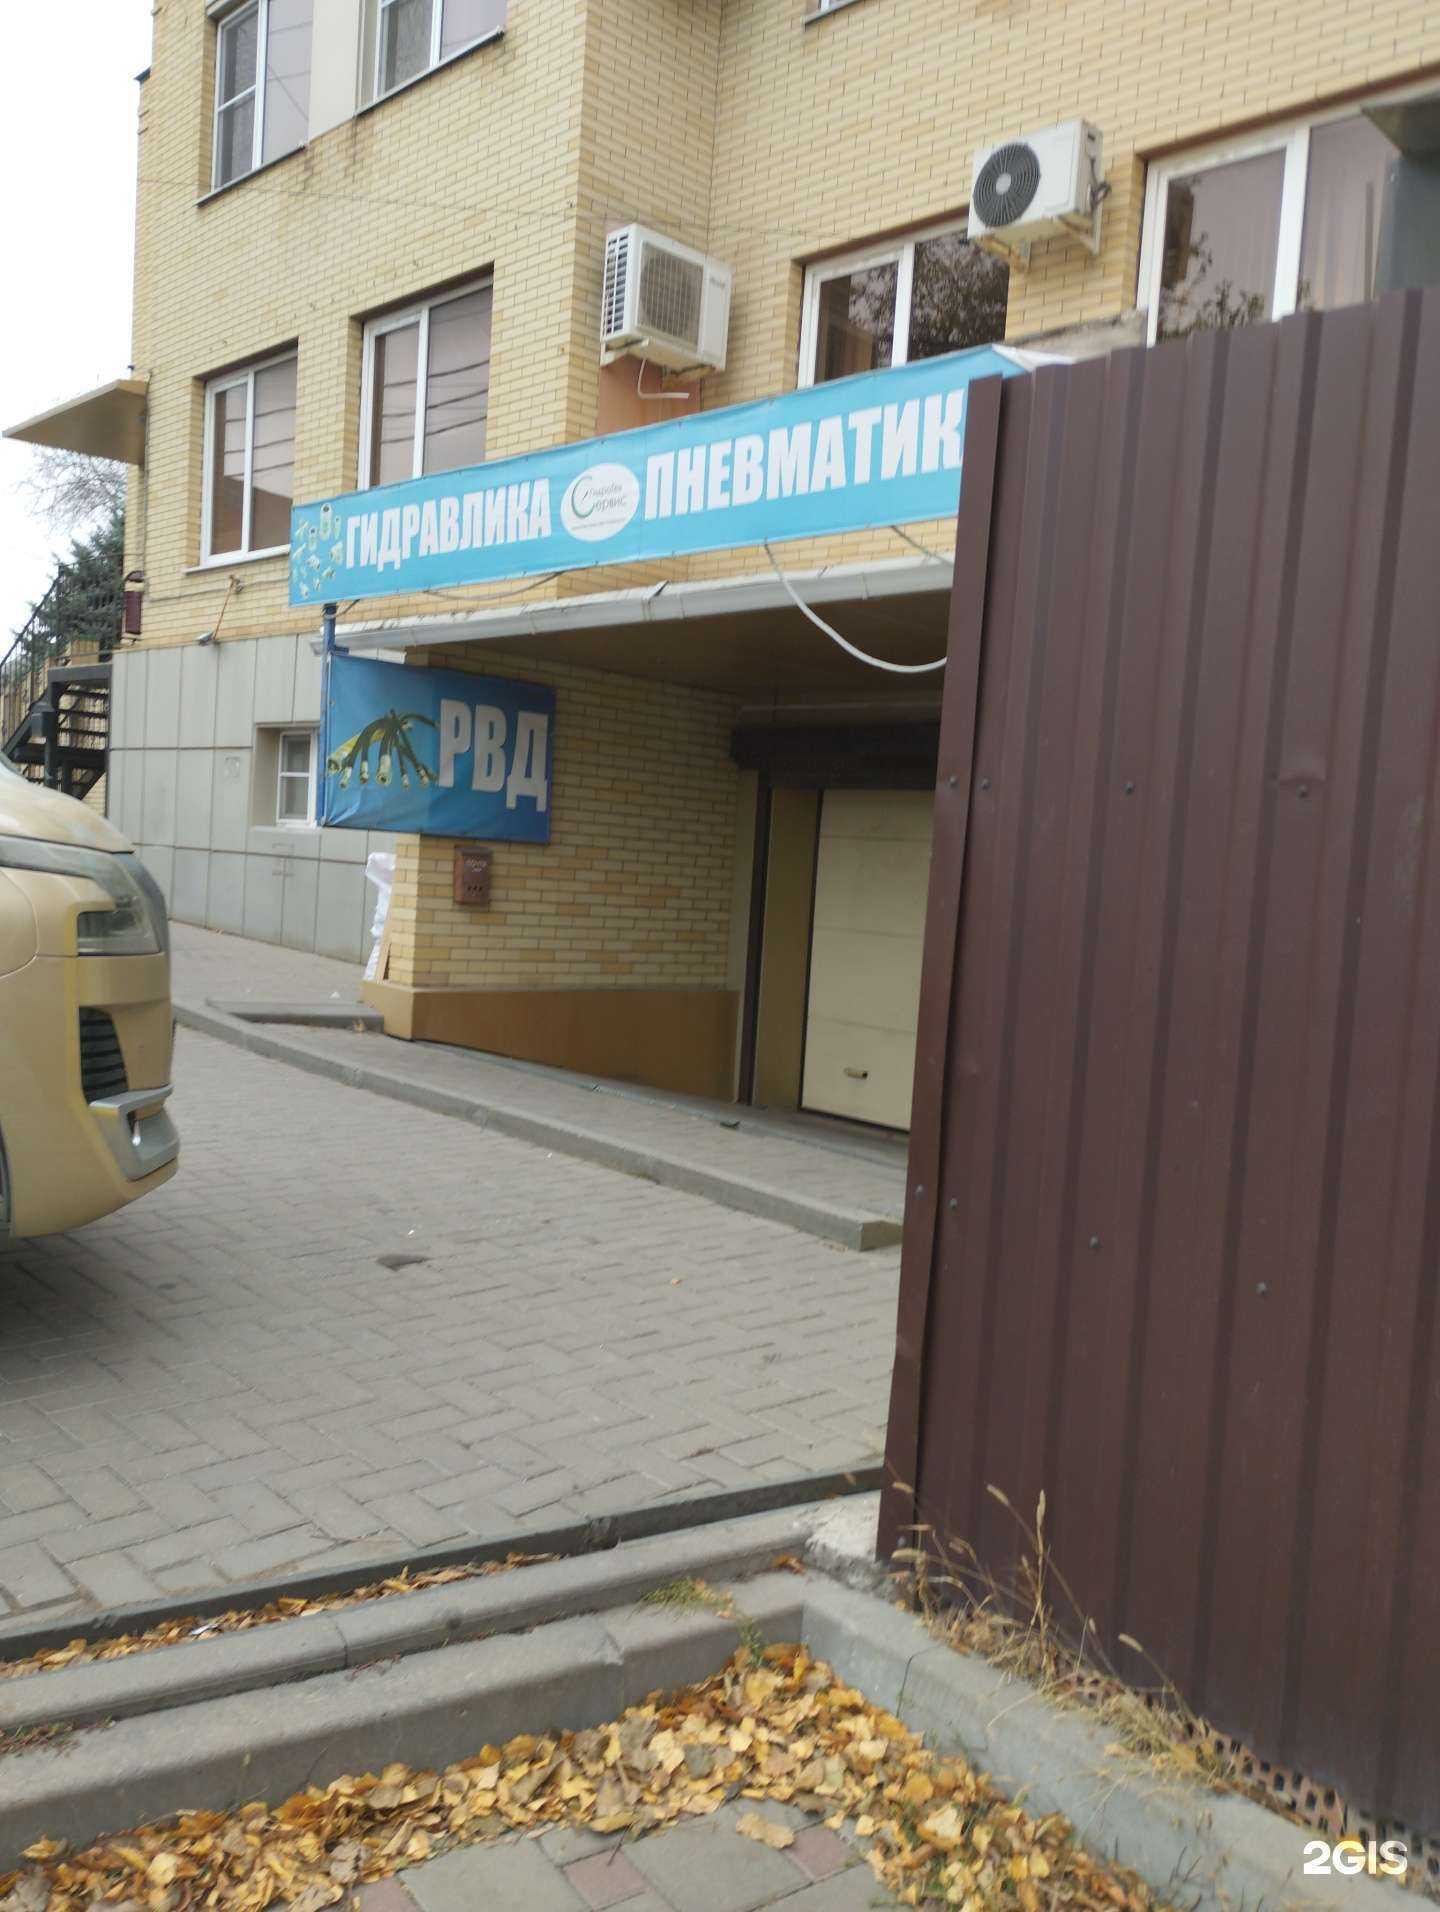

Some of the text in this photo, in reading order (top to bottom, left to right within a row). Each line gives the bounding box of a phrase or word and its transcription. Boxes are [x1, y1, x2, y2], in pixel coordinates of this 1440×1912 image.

[346, 388, 965, 572] ГИДРАВЛИКА ПНЕВМАТИК
[438, 698, 549, 812] РВД
